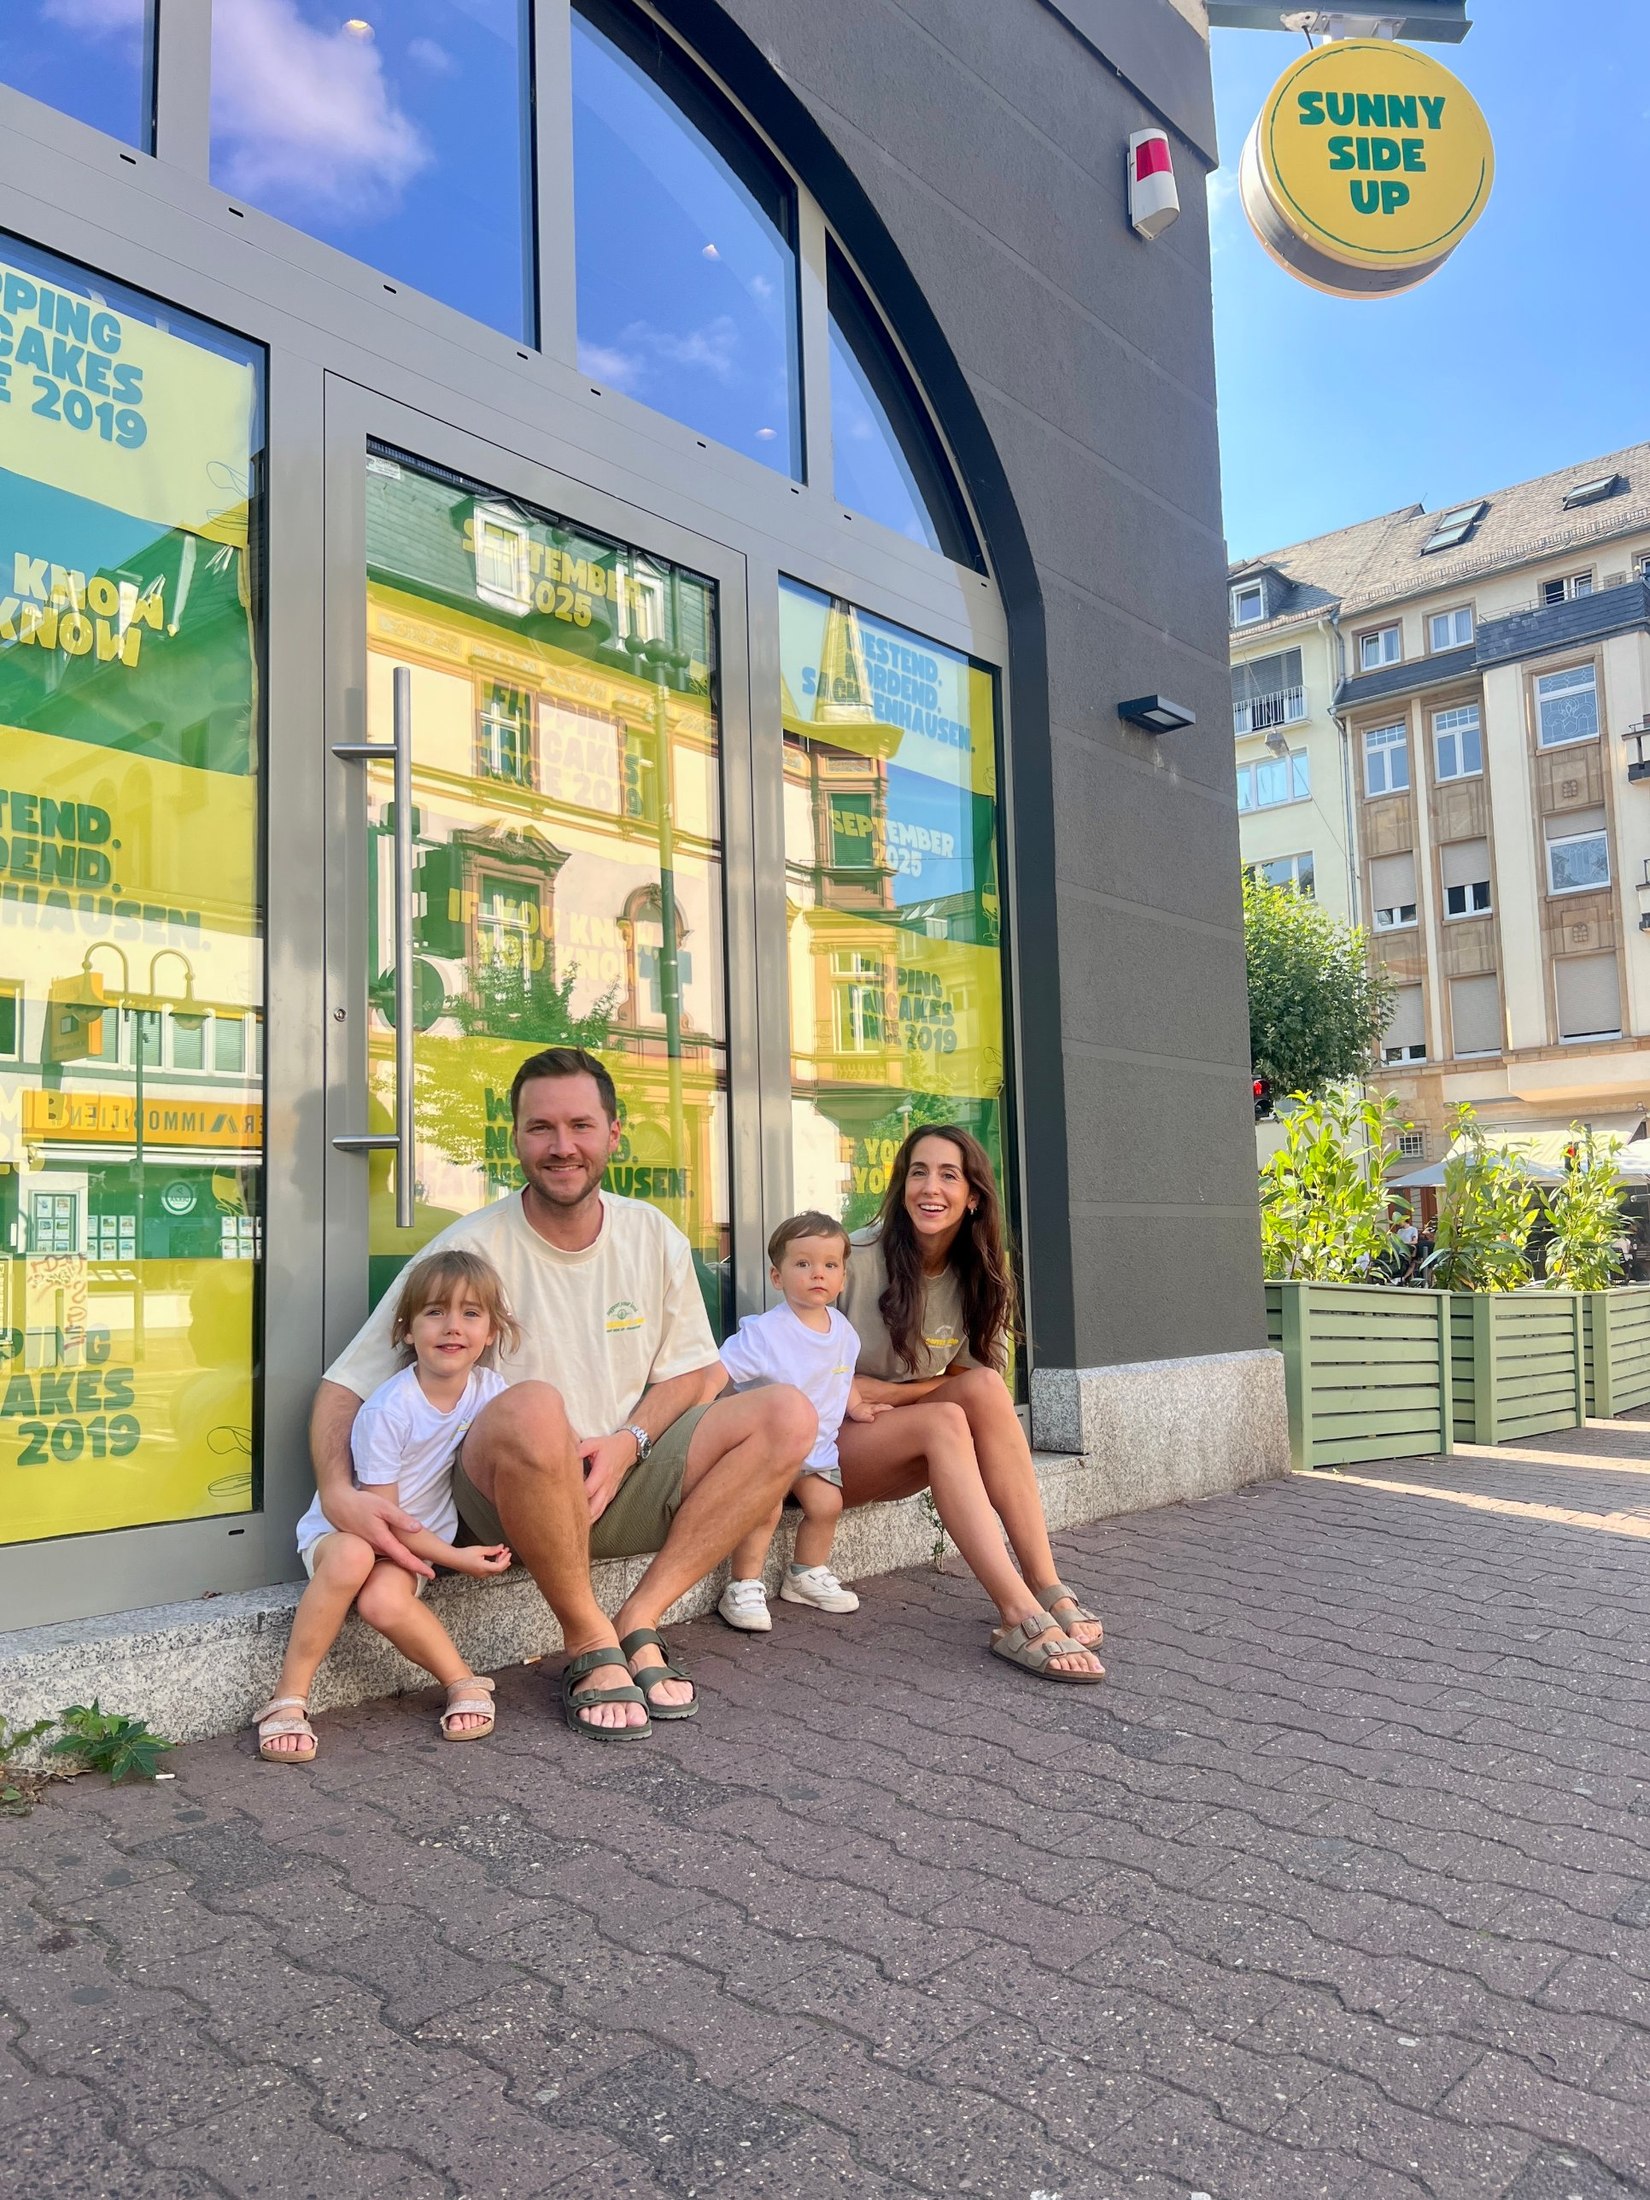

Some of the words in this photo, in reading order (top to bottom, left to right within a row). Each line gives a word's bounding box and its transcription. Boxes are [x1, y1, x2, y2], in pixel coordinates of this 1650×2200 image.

[1297, 90, 1446, 130] SUNNY
[1327, 135, 1427, 173] SIDE
[1349, 179, 1410, 215] UP
[0, 271, 121, 355] PING
[31, 374, 148, 450] 2019
[515, 570, 593, 628] 2025
[830, 808, 954, 858] SEPTEMBER
[871, 840, 922, 878] 2025
[904, 1023, 958, 1055] 2019
[0, 1367, 136, 1418] AKES
[17, 1413, 141, 1466] 2019
